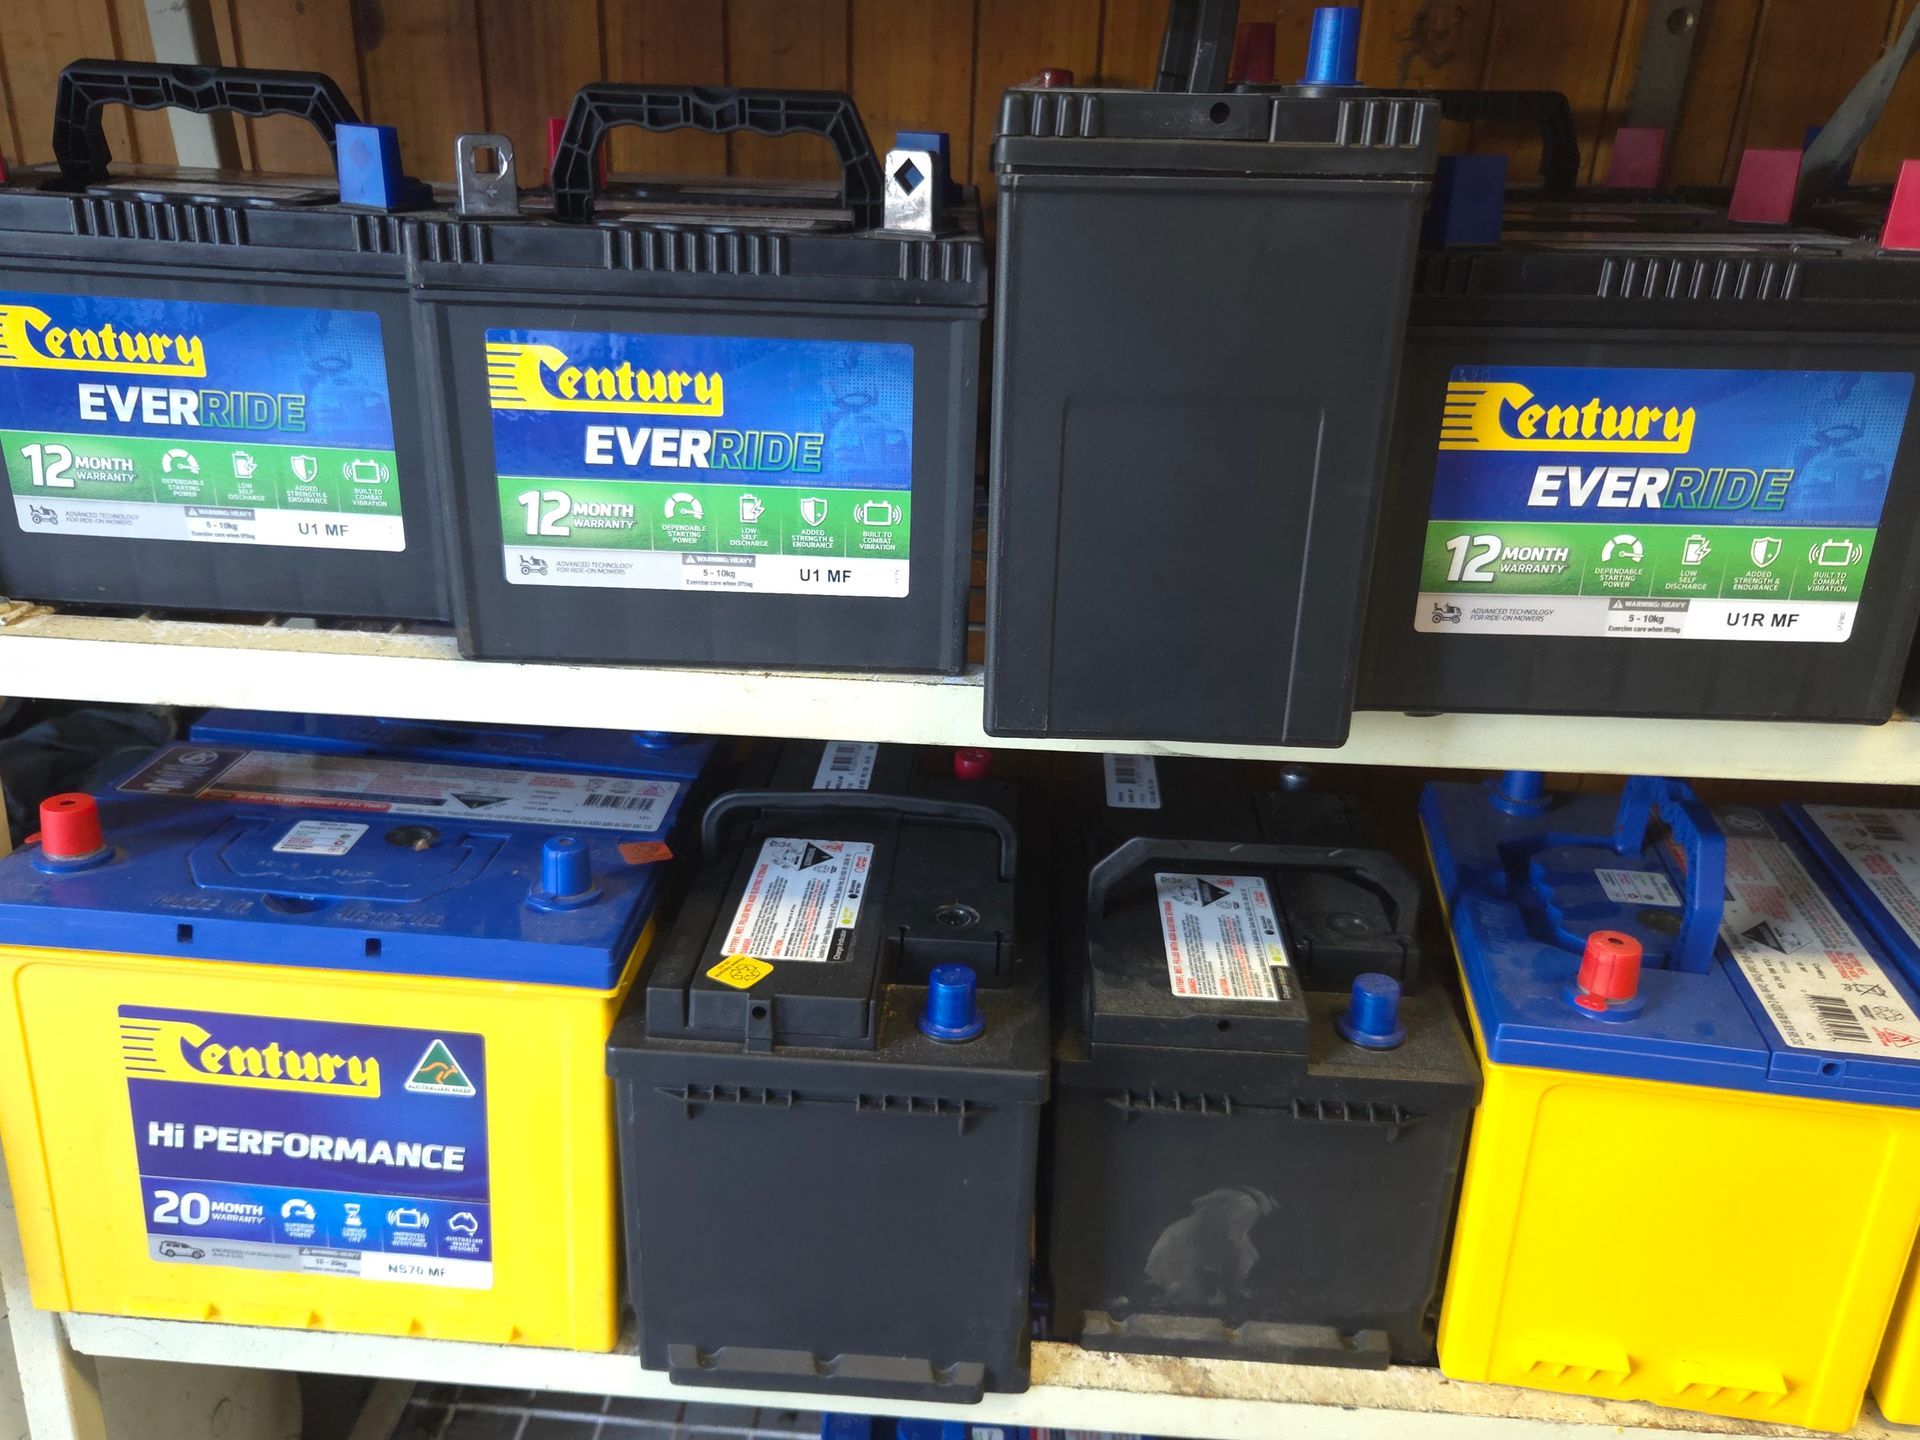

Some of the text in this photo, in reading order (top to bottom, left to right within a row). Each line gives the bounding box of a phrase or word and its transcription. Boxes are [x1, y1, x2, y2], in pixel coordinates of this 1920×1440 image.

[0, 304, 207, 378] Century
[486, 342, 724, 417] Century
[78, 383, 306, 432] EVERRIDE
[1438, 381, 1696, 454] Century
[585, 425, 825, 473] EVERRIDE
[20, 443, 75, 488] 12
[74, 455, 133, 471] MONTH
[172, 490, 198, 498] POWER
[287, 490, 321, 498] STRENGTH
[1527, 465, 1794, 511] EVERRIDE
[228, 494, 265, 502] DISCHARGE
[99, 512, 139, 520] TECHNOLOGY
[518, 489, 571, 537] 12
[573, 502, 634, 518] MONTH
[298, 522, 349, 536] U1 MF
[662, 524, 707, 532] DEPENDABLE
[792, 541, 833, 549] ENDURANCE
[730, 557, 753, 565] HEAVY
[1446, 534, 1502, 582] 12
[1501, 546, 1569, 562] MONTH
[703, 569, 708, 577] 5
[717, 569, 736, 579] 10kg
[800, 569, 852, 583] U1 MF
[1594, 567, 1643, 575] DEPENDABLE
[1600, 574, 1635, 582] STARTING
[1746, 570, 1772, 578] ADDED
[1814, 571, 1833, 579] BUILT
[1665, 583, 1707, 591] DISCHARGE
[1733, 583, 1779, 591] ENDURANCE
[1807, 584, 1847, 592] VIBRATION
[1625, 600, 1686, 609] WARNING: HEAVY
[1509, 608, 1555, 616] TECHNOLOGY
[1628, 615, 1635, 623] 5
[1643, 615, 1665, 625] 10kg
[1727, 612, 1799, 628] U1R MF
[1608, 625, 1633, 633] Exercise
[739, 911, 750, 925] FILLED
[833, 946, 845, 960] Charge
[118, 1017, 381, 1098] Century
[148, 1120, 466, 1172] Hi PERFORMANCE
[153, 1190, 210, 1226] 20
[211, 1201, 264, 1216] MONTH
[428, 1267, 447, 1277] MF
